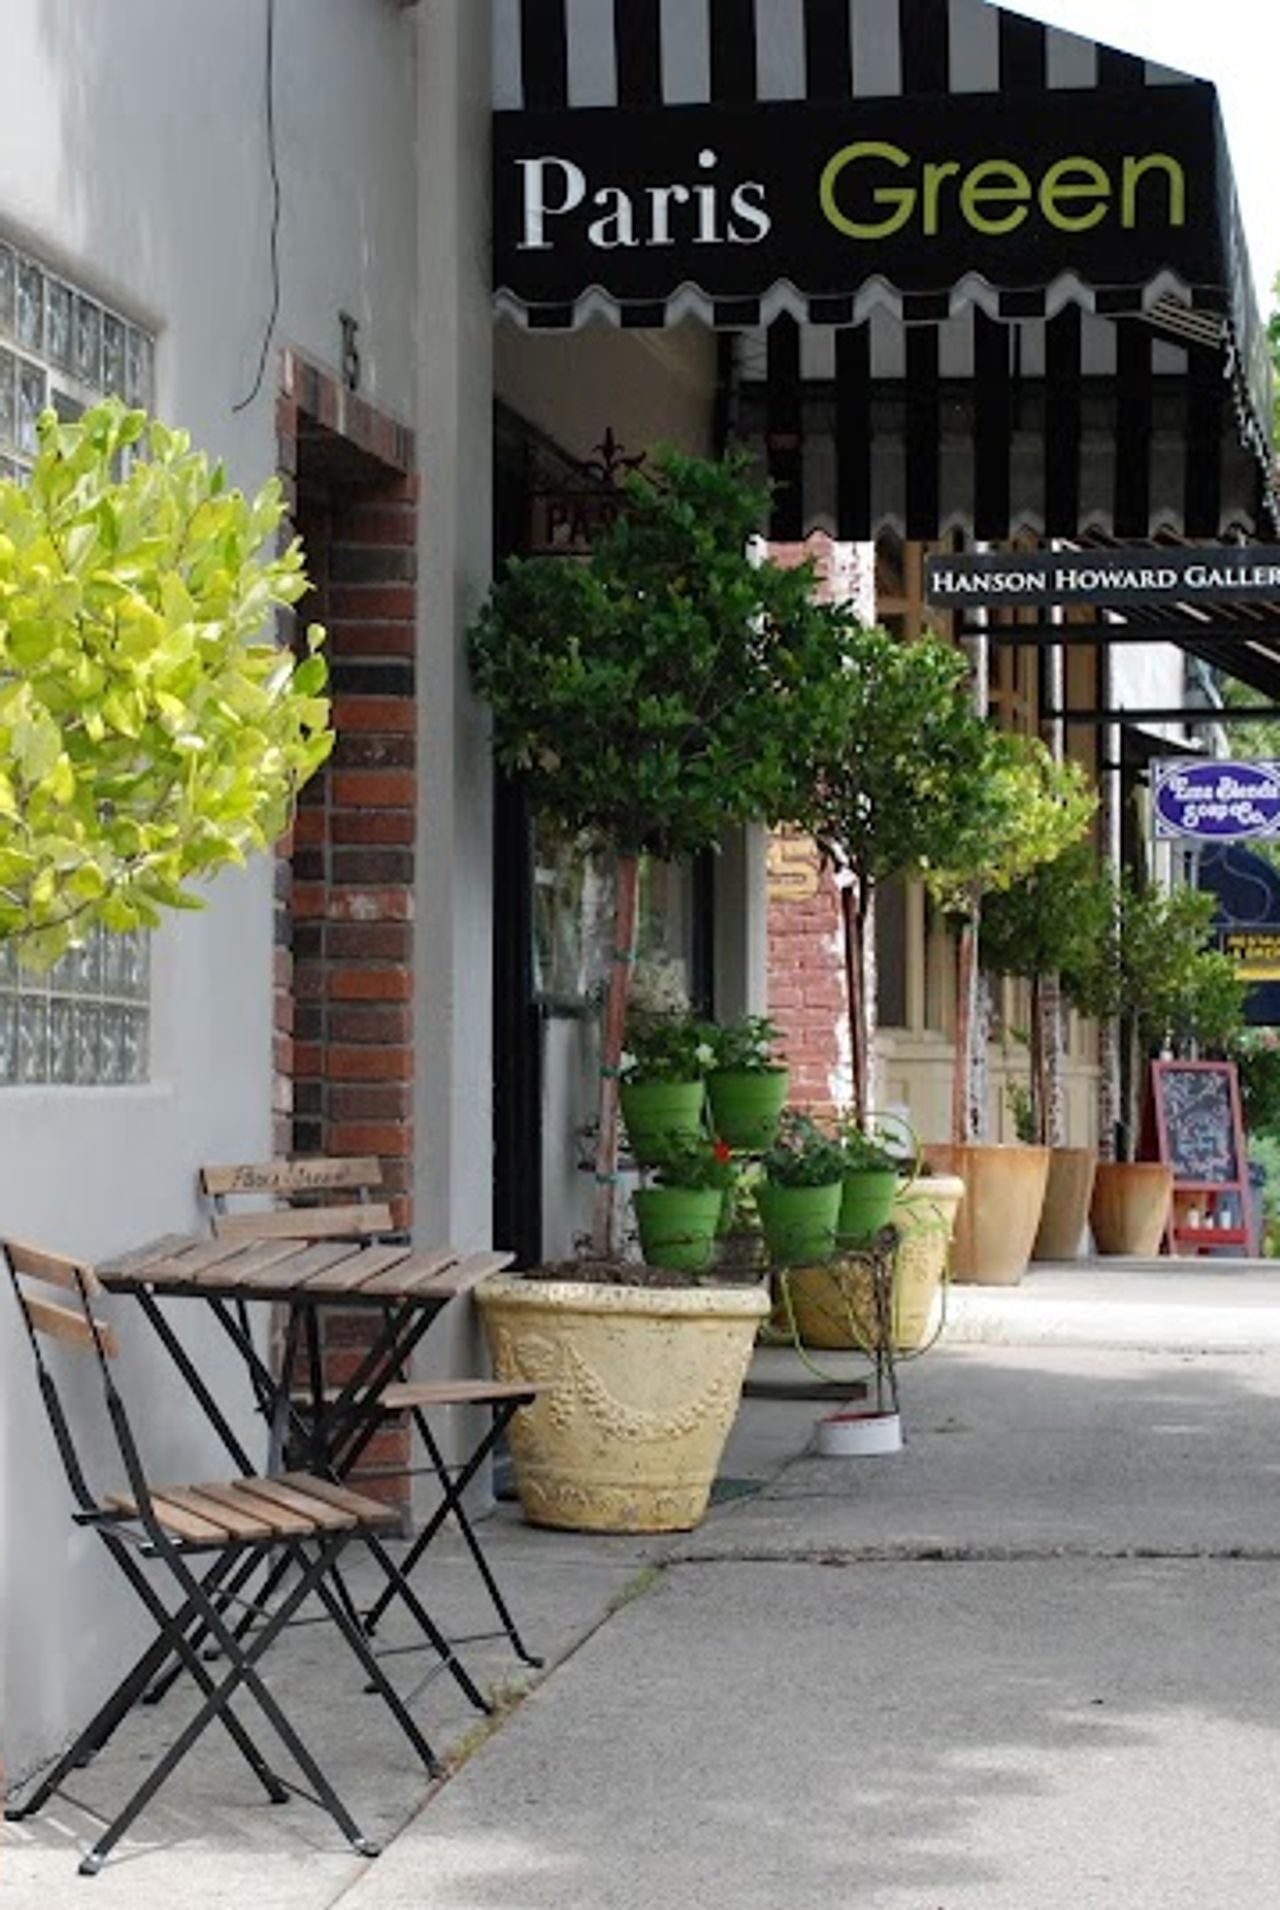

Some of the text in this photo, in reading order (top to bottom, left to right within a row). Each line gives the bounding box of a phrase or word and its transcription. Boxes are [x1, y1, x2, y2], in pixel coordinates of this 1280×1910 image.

[513, 139, 1186, 251] Paris Green
[931, 569, 1047, 593] HANSON
[1055, 568, 1177, 591] HOWARD
